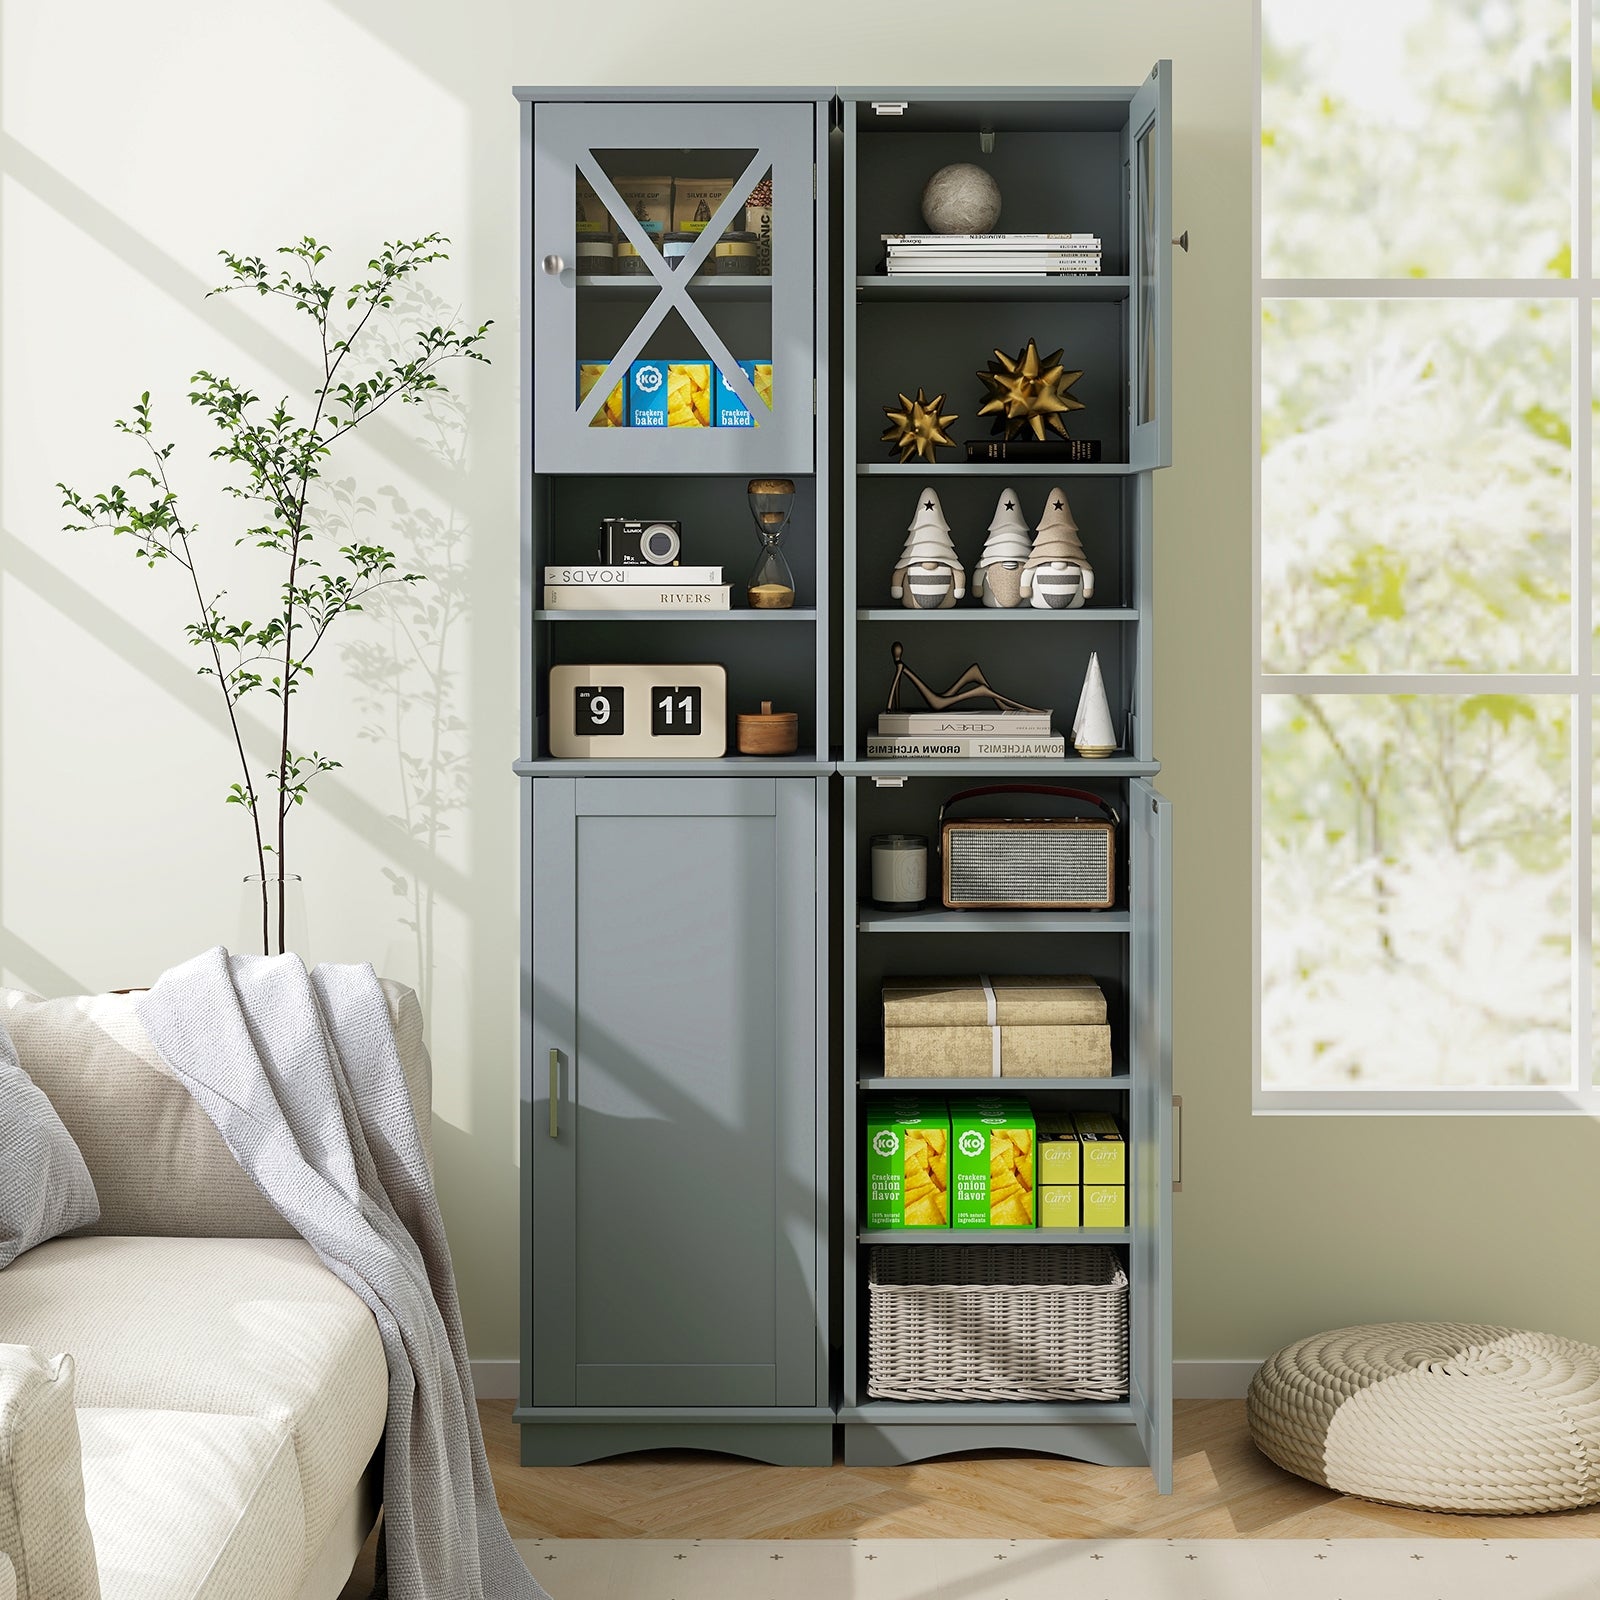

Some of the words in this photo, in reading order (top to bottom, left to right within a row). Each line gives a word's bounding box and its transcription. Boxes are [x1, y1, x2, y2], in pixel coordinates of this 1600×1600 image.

[761, 214, 770, 275] ORGANIC
[642, 374, 656, 384] KO
[635, 415, 664, 425] baked
[721, 415, 750, 425] baked
[562, 570, 624, 583] ROADS
[660, 593, 711, 603] RIVERS
[590, 696, 610, 725] 9
[659, 696, 693, 724] 11
[878, 1139, 894, 1149] KO
[964, 1139, 980, 1149] KO
[1045, 1149, 1072, 1161] Carr's
[1090, 1149, 1117, 1161] Carr's
[872, 1181, 900, 1190] onion
[957, 1181, 986, 1190] onion
[872, 1190, 900, 1201] flavor
[957, 1190, 986, 1201] flavor
[1045, 1192, 1072, 1204] Carr's
[1090, 1192, 1117, 1204] Carr's
